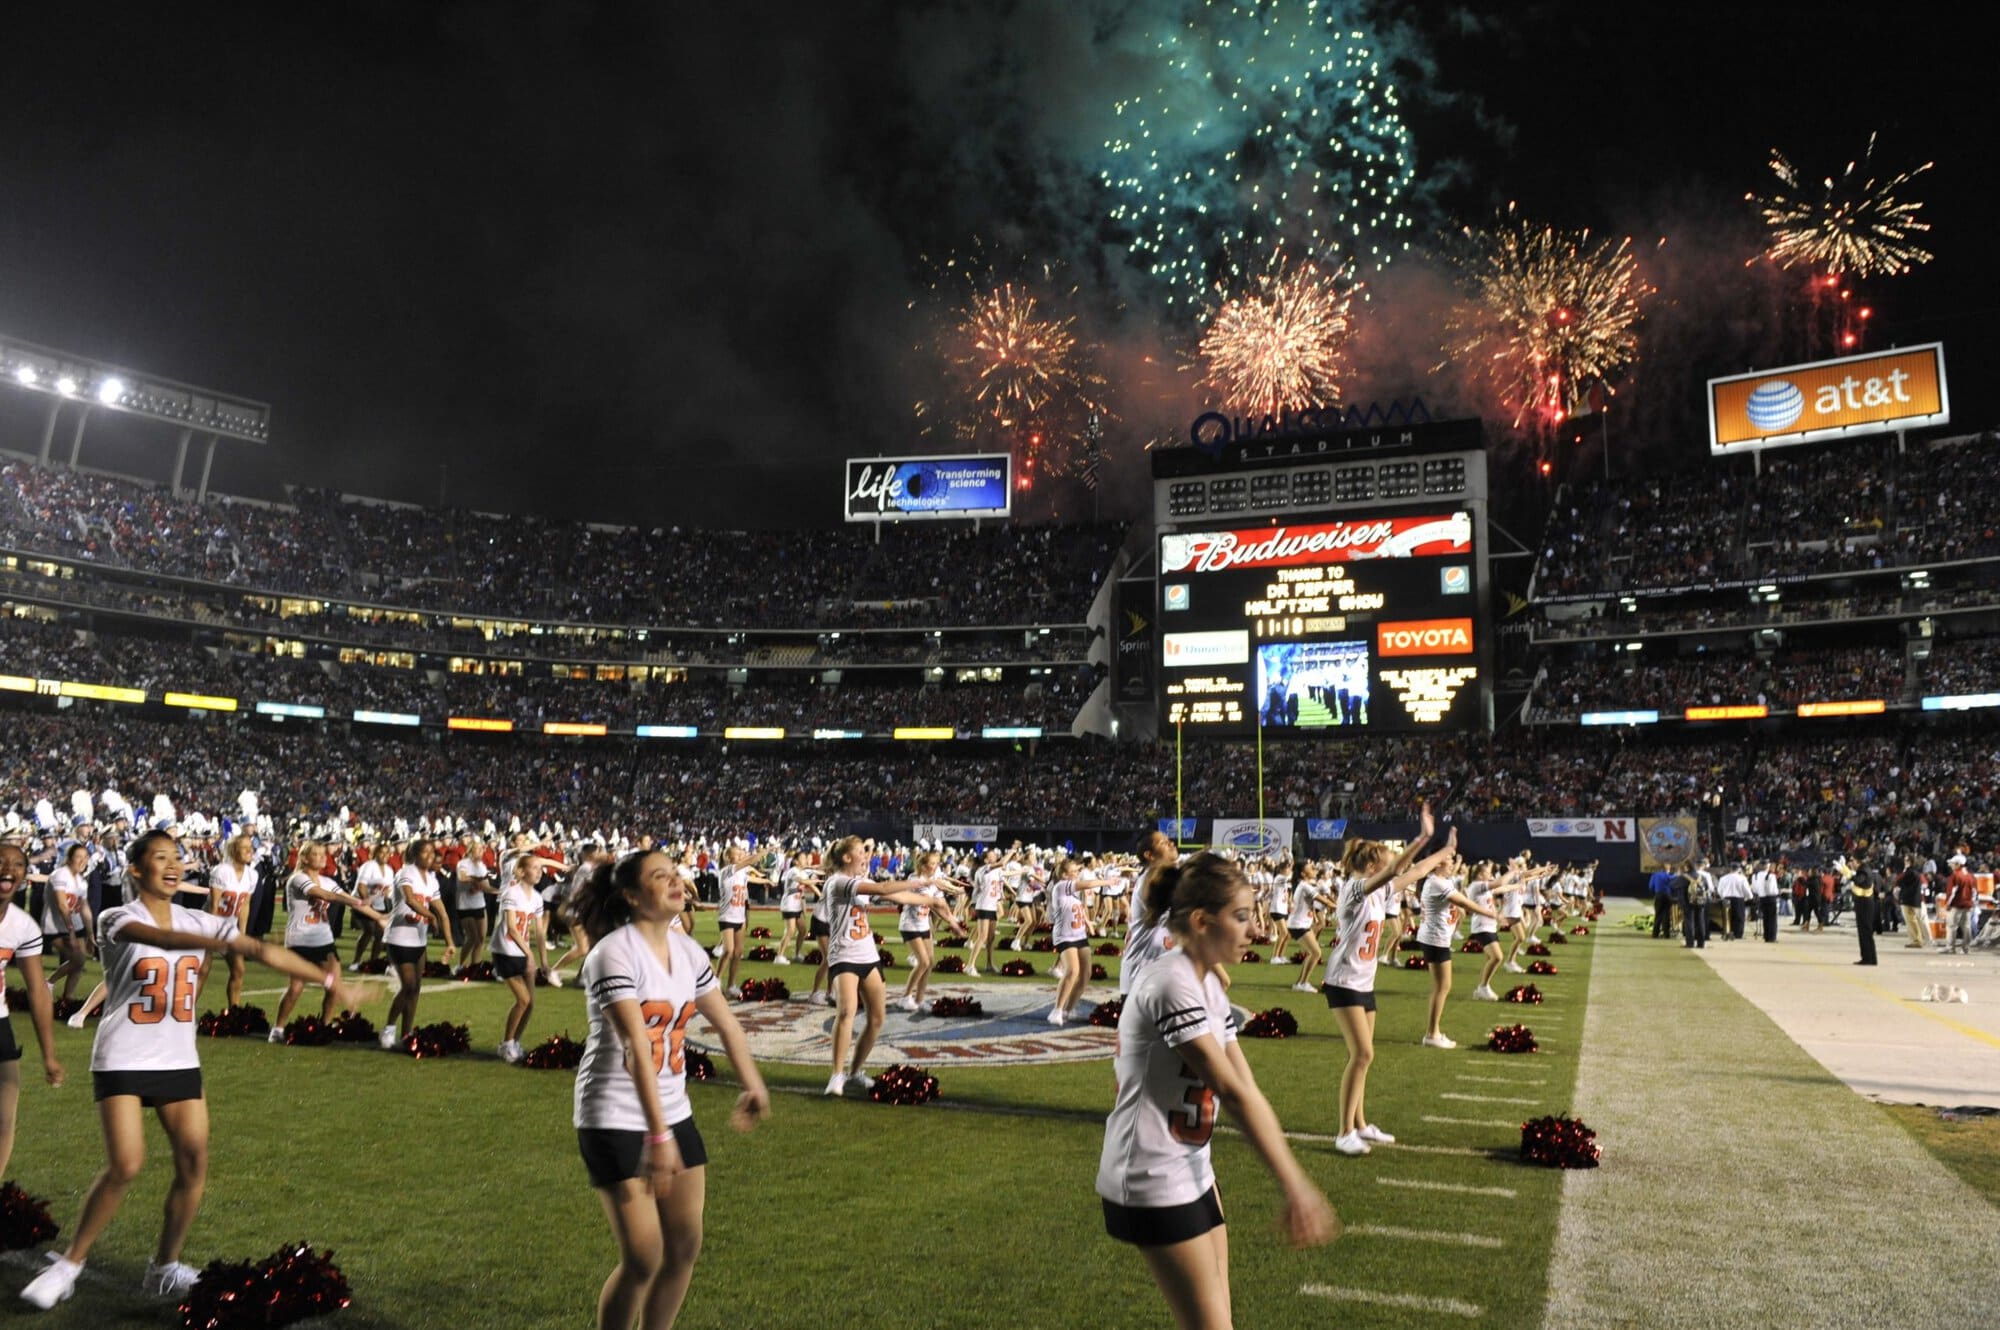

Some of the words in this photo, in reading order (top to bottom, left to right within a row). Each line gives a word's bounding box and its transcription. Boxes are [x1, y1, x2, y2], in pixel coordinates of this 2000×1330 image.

[1814, 367, 1911, 415] at&t
[1240, 432, 1412, 459] STADIUM
[935, 468, 1001, 480] Transforming
[949, 478, 987, 488] science
[850, 464, 903, 511] life
[887, 496, 946, 508] technologies
[1186, 520, 1393, 573] Budweiser
[1327, 565, 1344, 579] TO
[1266, 583, 1289, 599] DR
[1295, 579, 1355, 597] PEPPER
[1119, 640, 1150, 653] Sprint
[1382, 628, 1468, 649] TOYOTA
[1603, 820, 1627, 840] N
[128, 955, 201, 1025] 36
